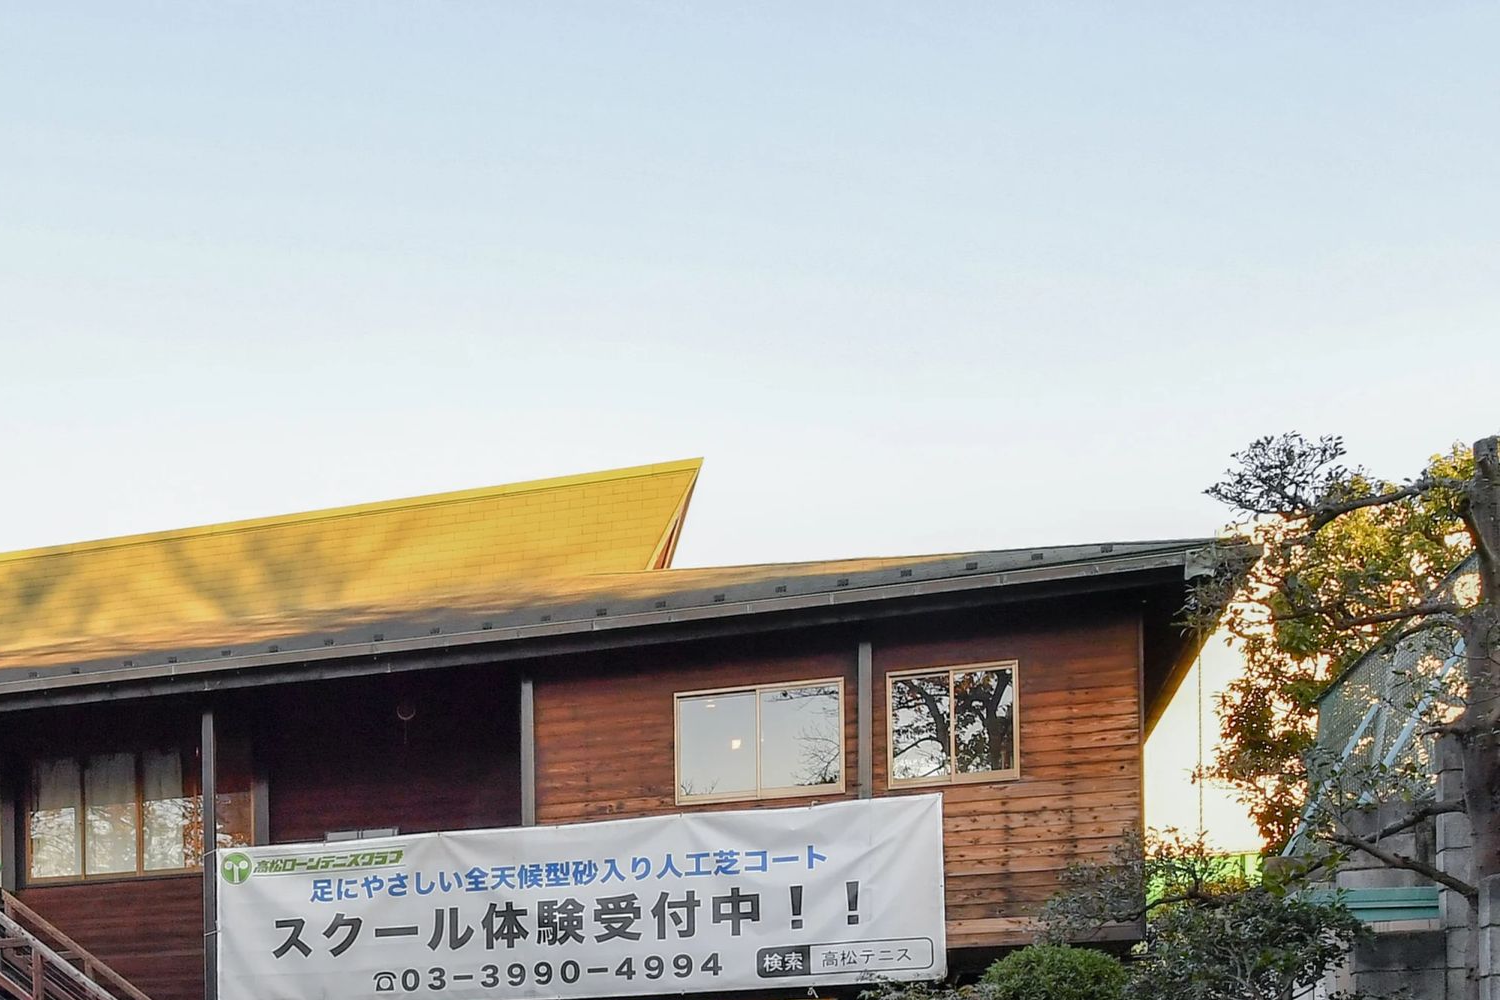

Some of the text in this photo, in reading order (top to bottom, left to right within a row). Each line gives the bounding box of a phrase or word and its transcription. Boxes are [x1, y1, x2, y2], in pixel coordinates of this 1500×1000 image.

[253, 849, 404, 874] 高松ローンテニスクラブ
[310, 845, 828, 903] 足にやさしい全天候型砂入り人工芝コート
[762, 947, 912, 973] 検索 高松テニス
